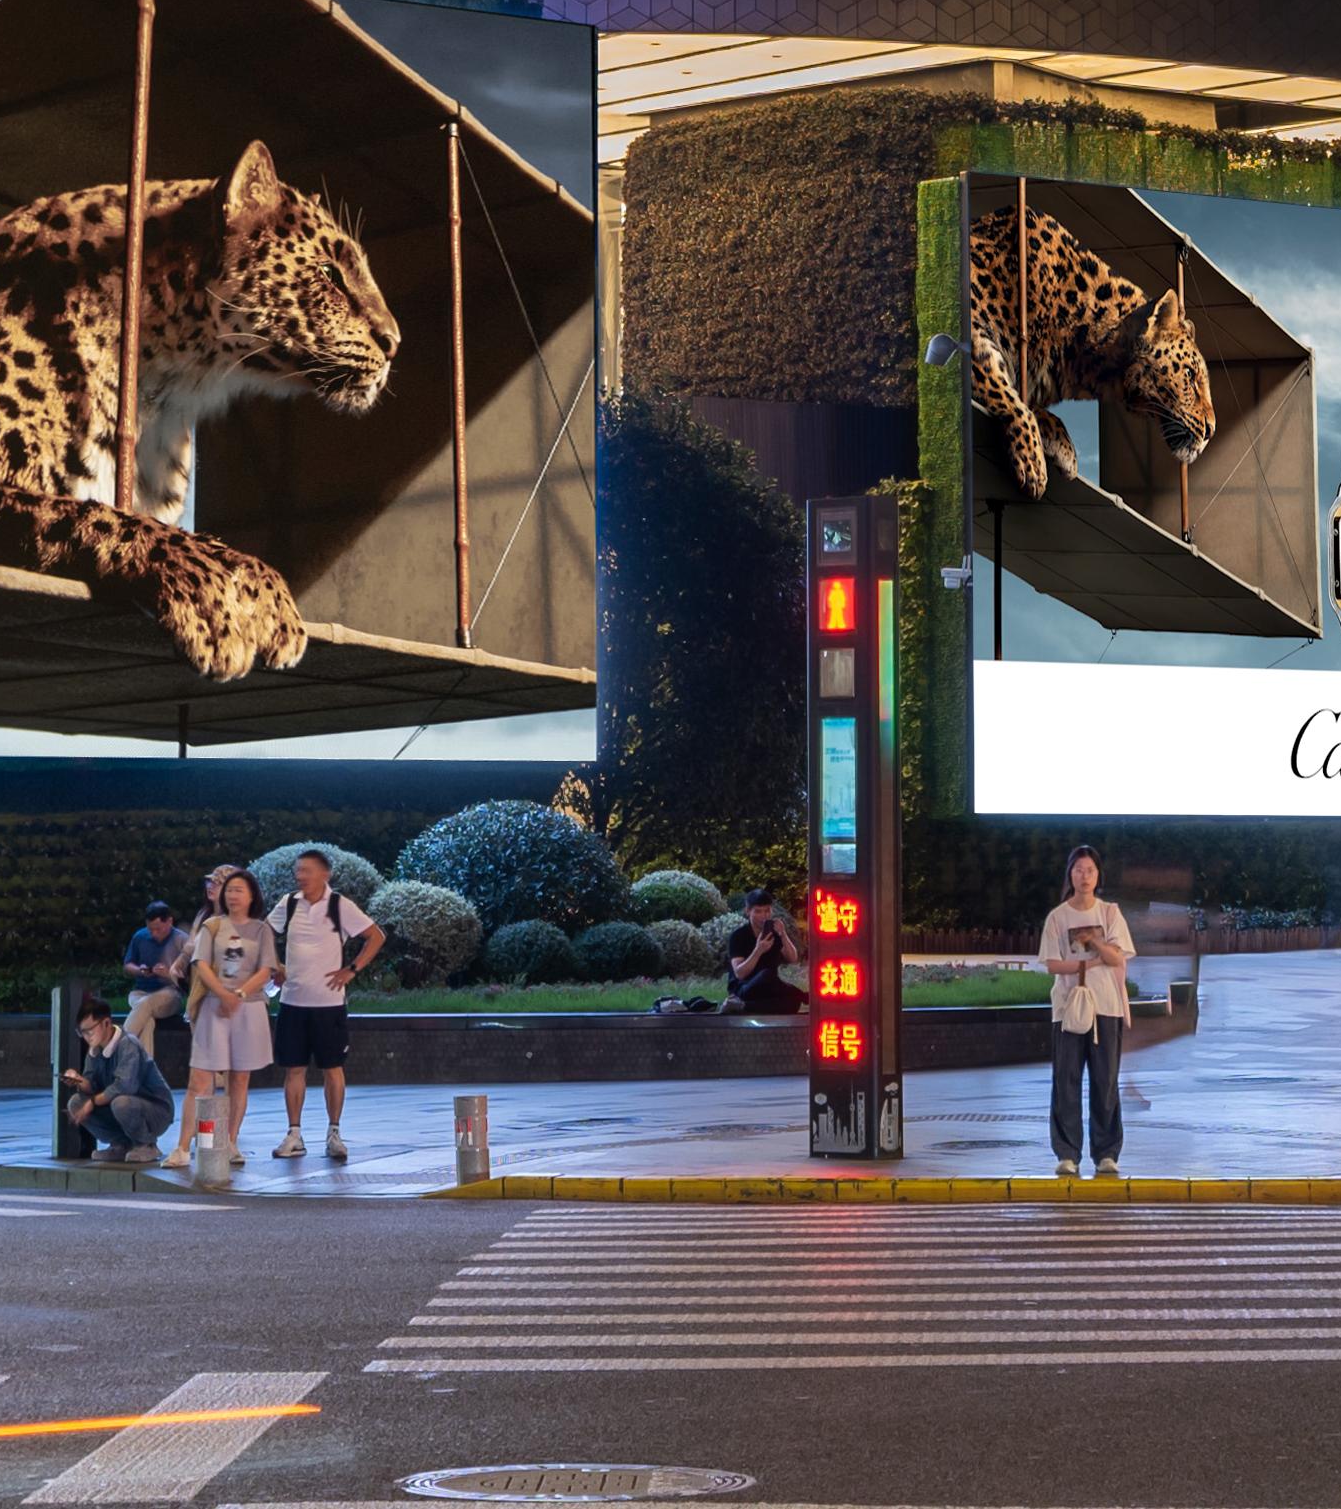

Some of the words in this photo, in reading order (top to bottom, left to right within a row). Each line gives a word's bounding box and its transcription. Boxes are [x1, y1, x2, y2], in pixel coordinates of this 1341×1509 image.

[817, 892, 858, 934] 遵守
[820, 960, 859, 996] 交通
[820, 1021, 862, 1061] 信号
